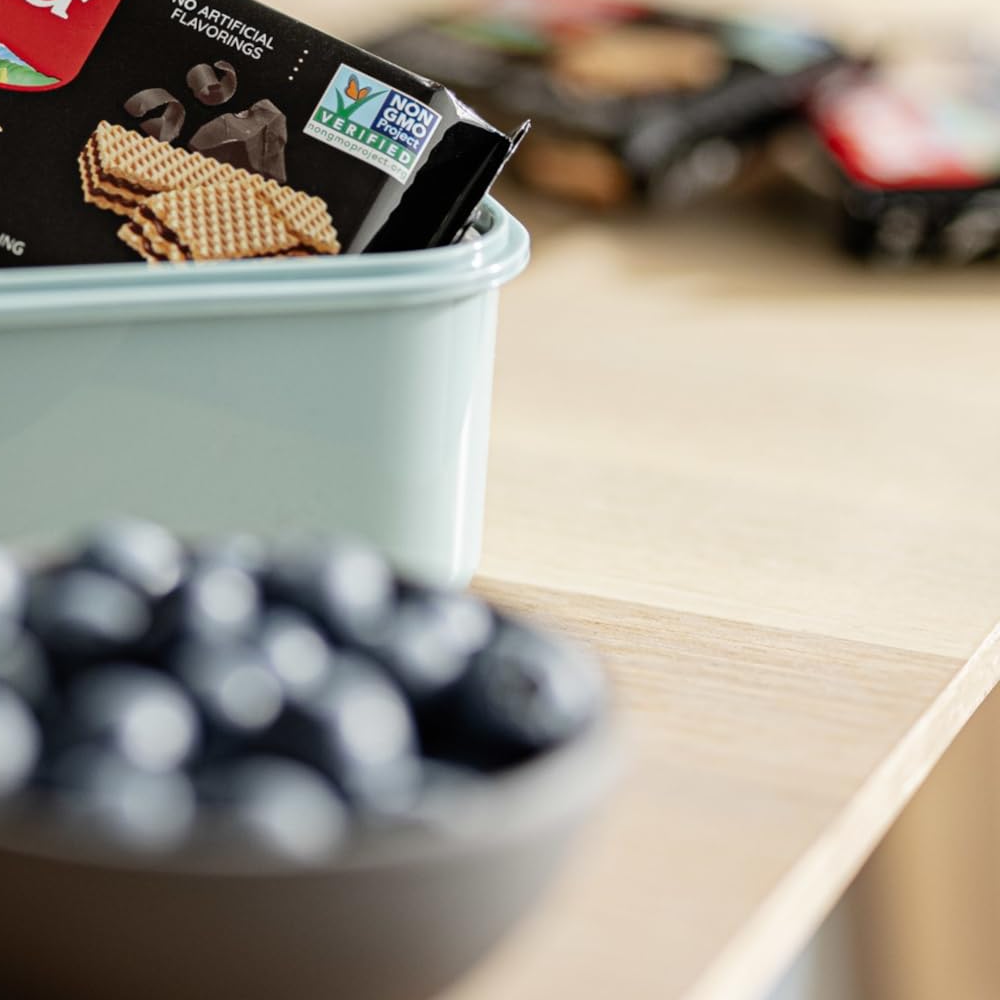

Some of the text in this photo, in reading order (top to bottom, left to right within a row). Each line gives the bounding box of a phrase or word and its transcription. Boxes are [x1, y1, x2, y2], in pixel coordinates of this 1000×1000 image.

[170, 8, 264, 60] FLAVORINGS
[198, 6, 275, 50] ARTIFICIAL
[383, 107, 427, 138] GMO
[390, 94, 434, 126] NON
[307, 122, 408, 178] nongmoproject.org
[320, 111, 411, 165] VERIFIED
[376, 118, 420, 150] Project
